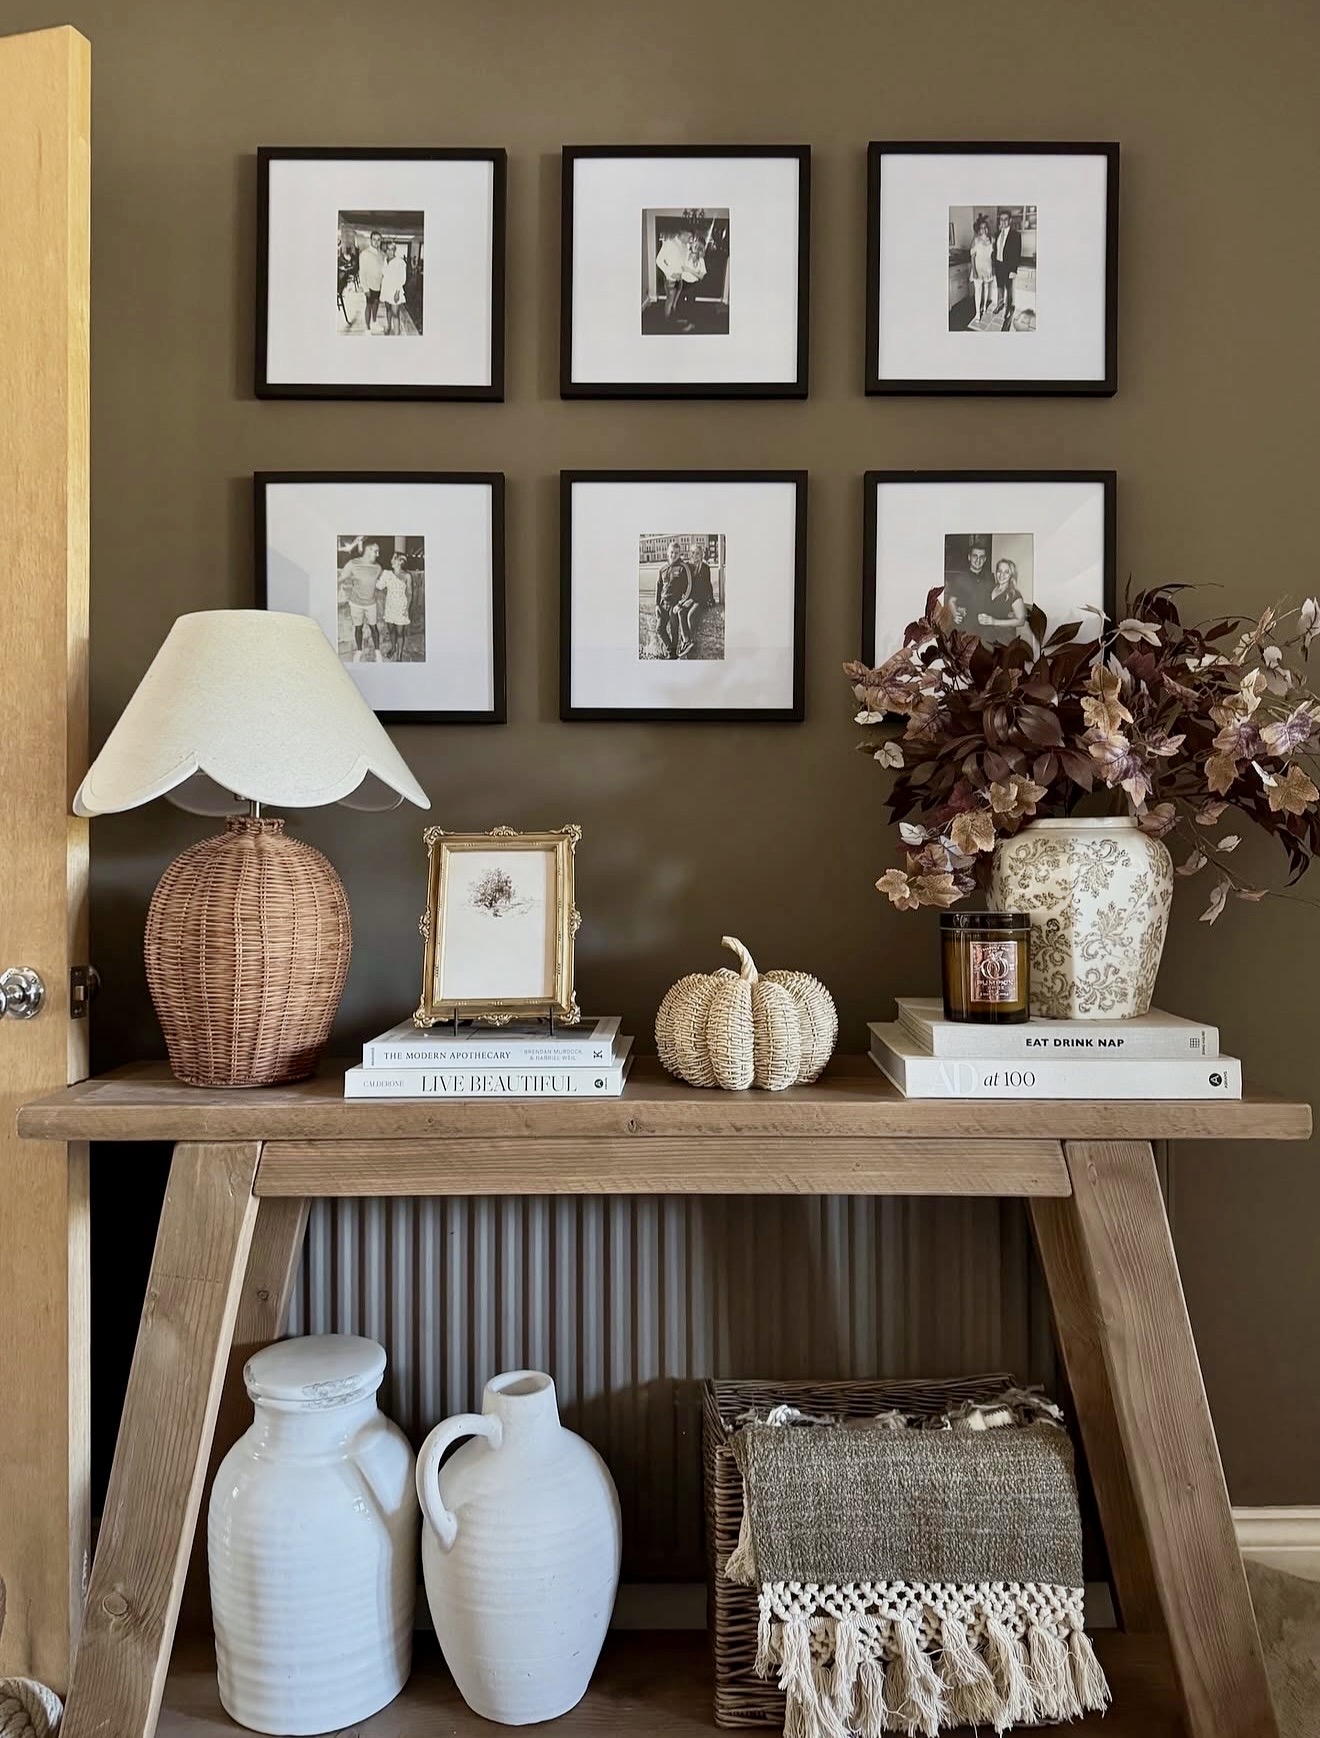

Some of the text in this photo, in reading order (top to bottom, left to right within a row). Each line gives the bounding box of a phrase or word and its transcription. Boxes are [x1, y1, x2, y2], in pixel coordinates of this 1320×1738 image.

[1025, 1038, 1125, 1048] EAT DRINK NAP
[384, 1052, 402, 1060] THE
[406, 1051, 447, 1060] MODERN
[449, 1051, 511, 1060] APOTHECARY
[593, 1050, 603, 1059] K
[422, 1075, 578, 1092] LIVE BEAUTIFUL
[983, 1072, 999, 1087] at
[1004, 1071, 1036, 1087] 100
[364, 1080, 404, 1088] CALDERONE
